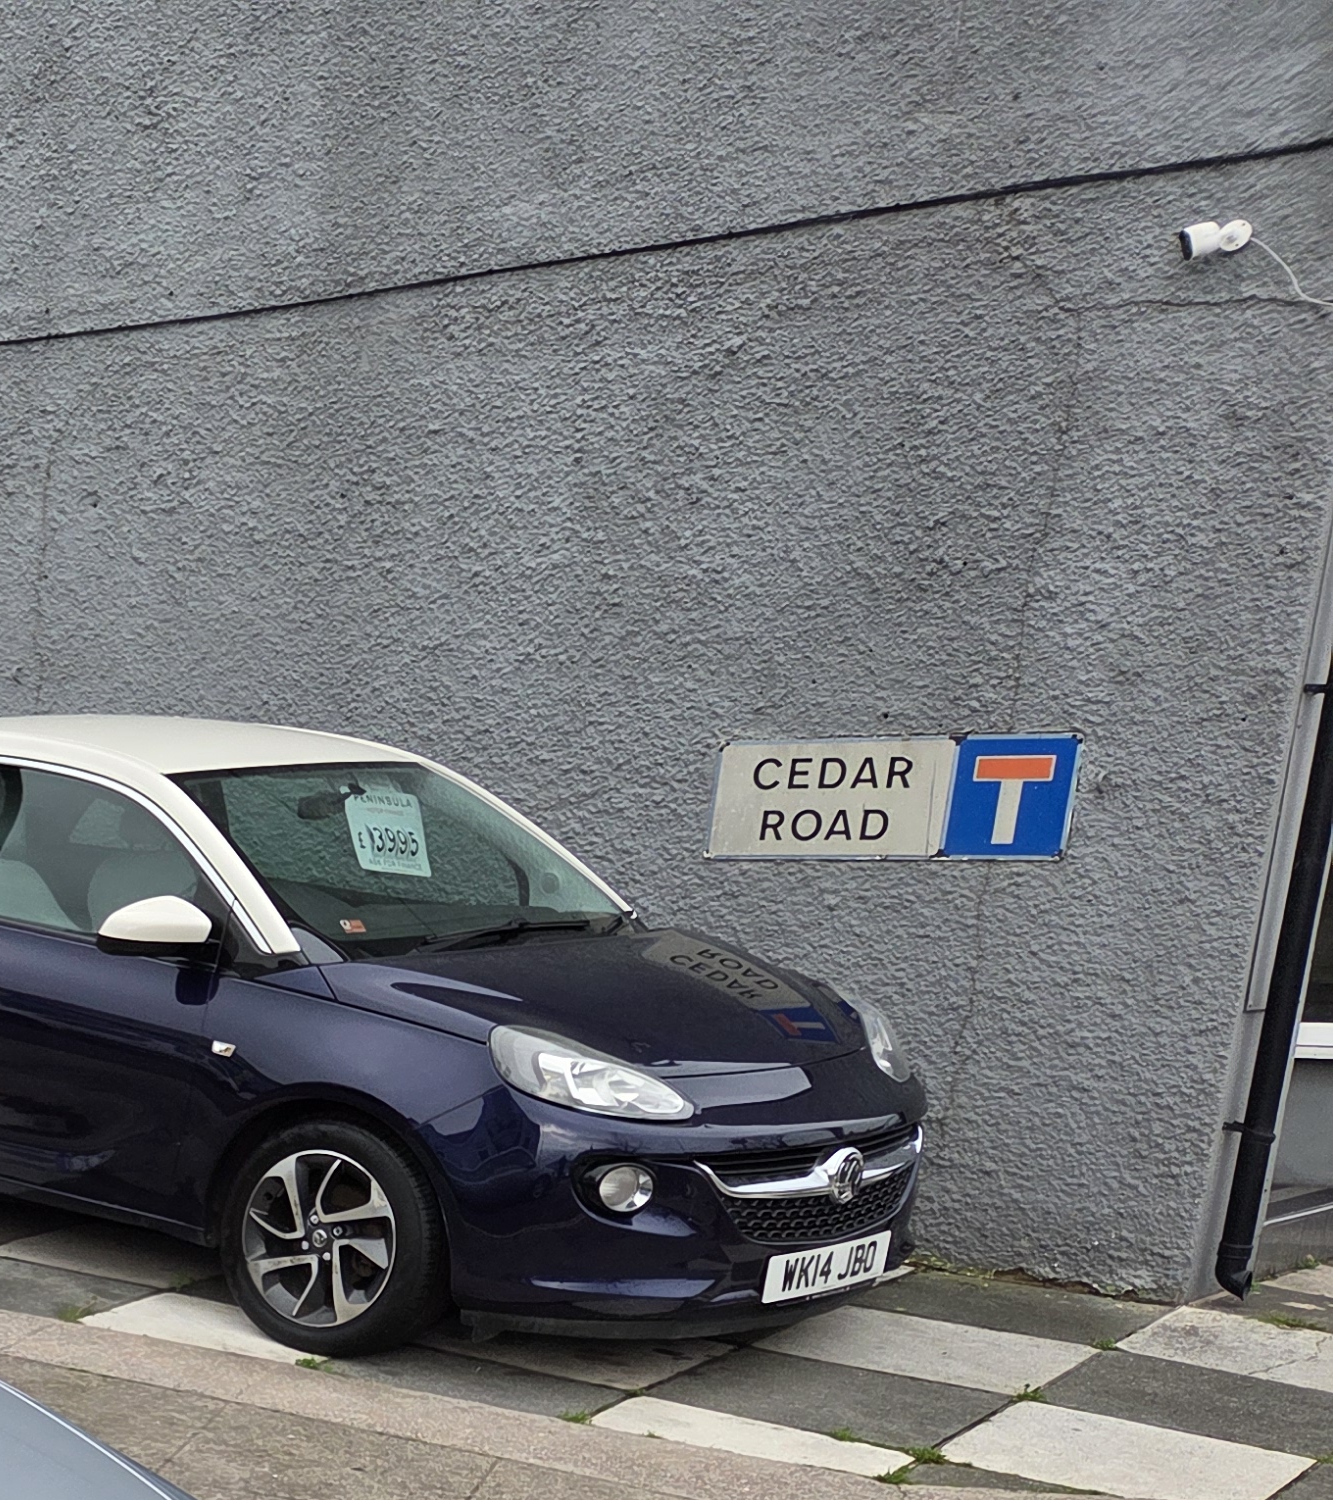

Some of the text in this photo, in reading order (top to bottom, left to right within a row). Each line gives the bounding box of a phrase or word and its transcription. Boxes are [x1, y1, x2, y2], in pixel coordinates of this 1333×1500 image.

[753, 756, 913, 790] CEDAR
[353, 794, 413, 808] PENINSULA
[372, 827, 419, 857] 3995
[758, 808, 890, 842] ROAD
[781, 1240, 878, 1292] WK14 JBO
